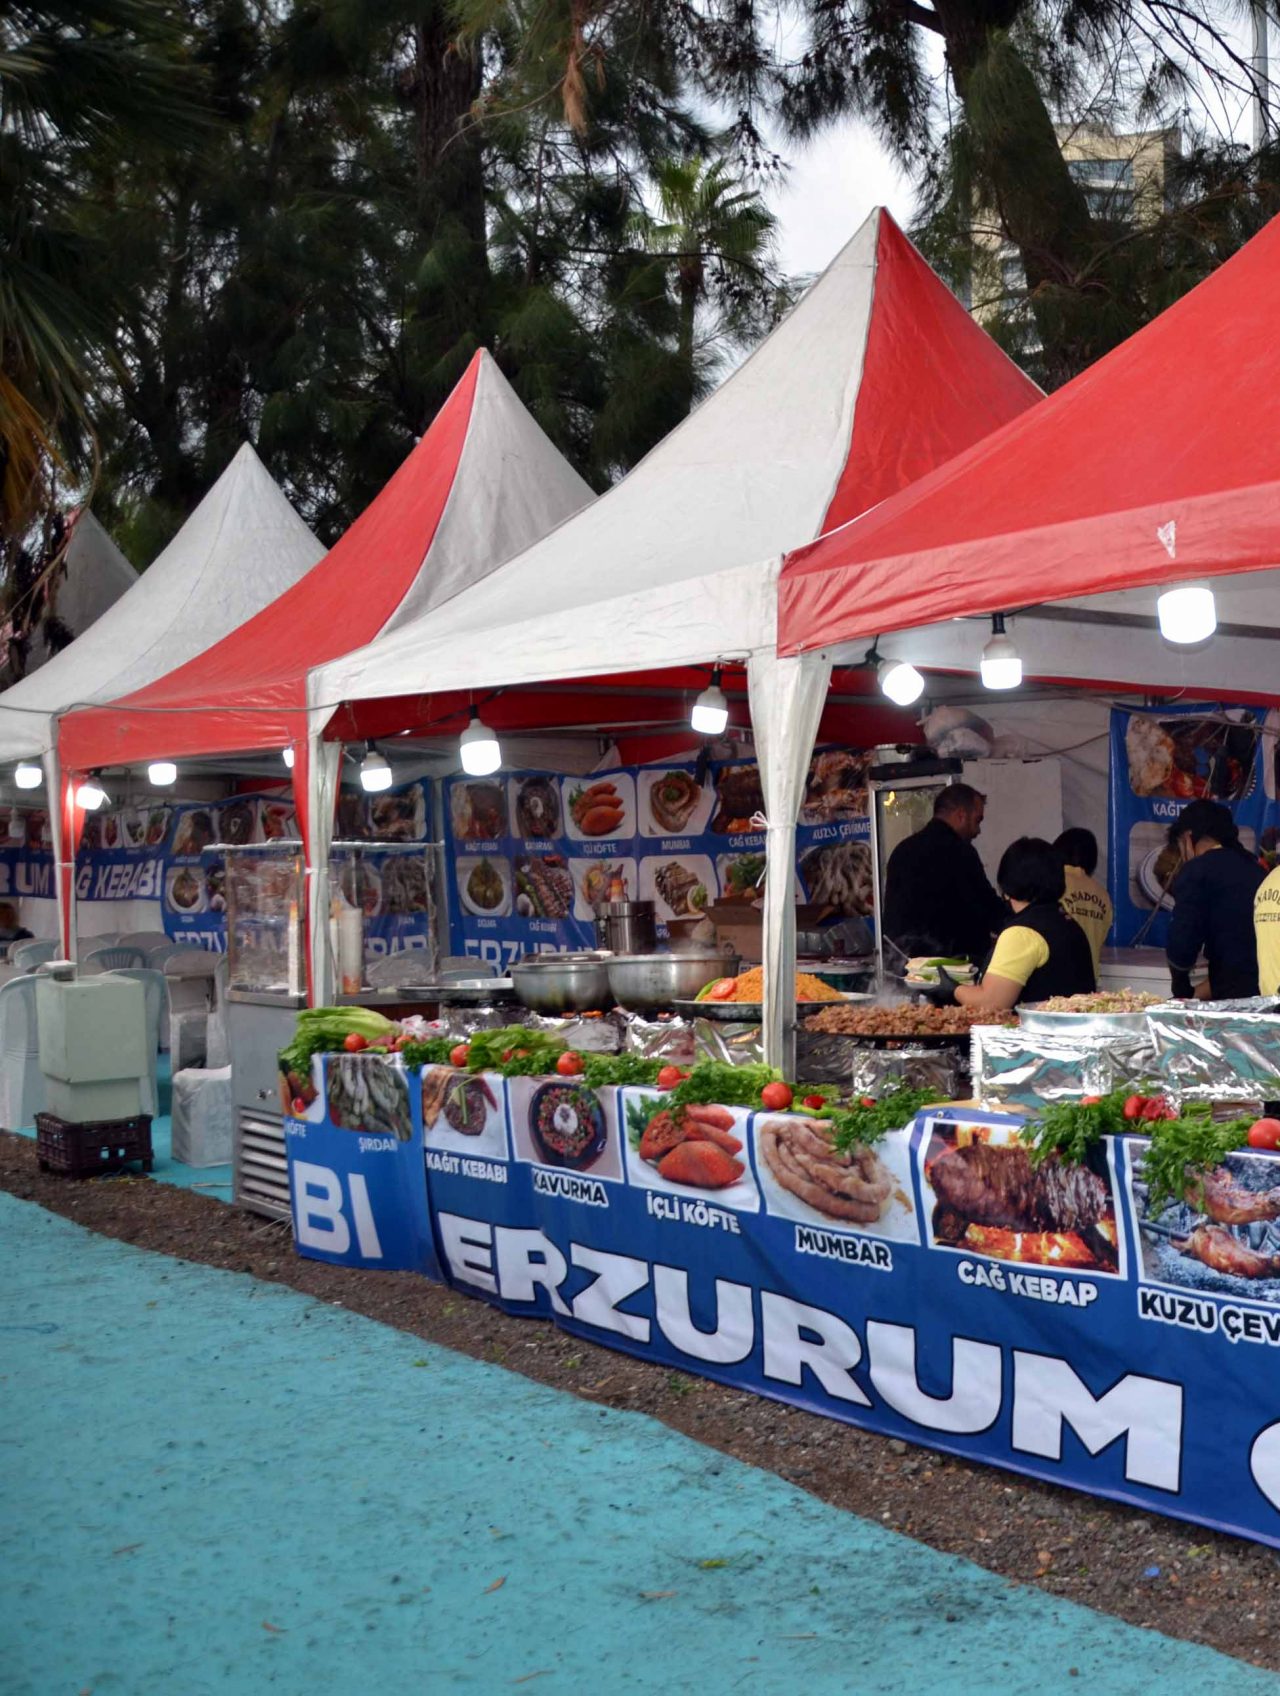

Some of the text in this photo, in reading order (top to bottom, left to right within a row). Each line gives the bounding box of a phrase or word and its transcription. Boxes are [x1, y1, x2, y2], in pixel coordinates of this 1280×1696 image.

[1153, 800, 1197, 817] KAĞI
[94, 859, 164, 898] KEBABI
[426, 1152, 508, 1184] KAĞIT KEBABI
[532, 1169, 608, 1206] KAVURMA
[646, 1190, 741, 1235] İÇLİ KÖFTE
[795, 1225, 893, 1271] MUMBAR
[957, 1260, 1098, 1307] CAĞ KEBAP
[1138, 1287, 1217, 1330] KUZU
[437, 1210, 1184, 1493] ERZURUM
